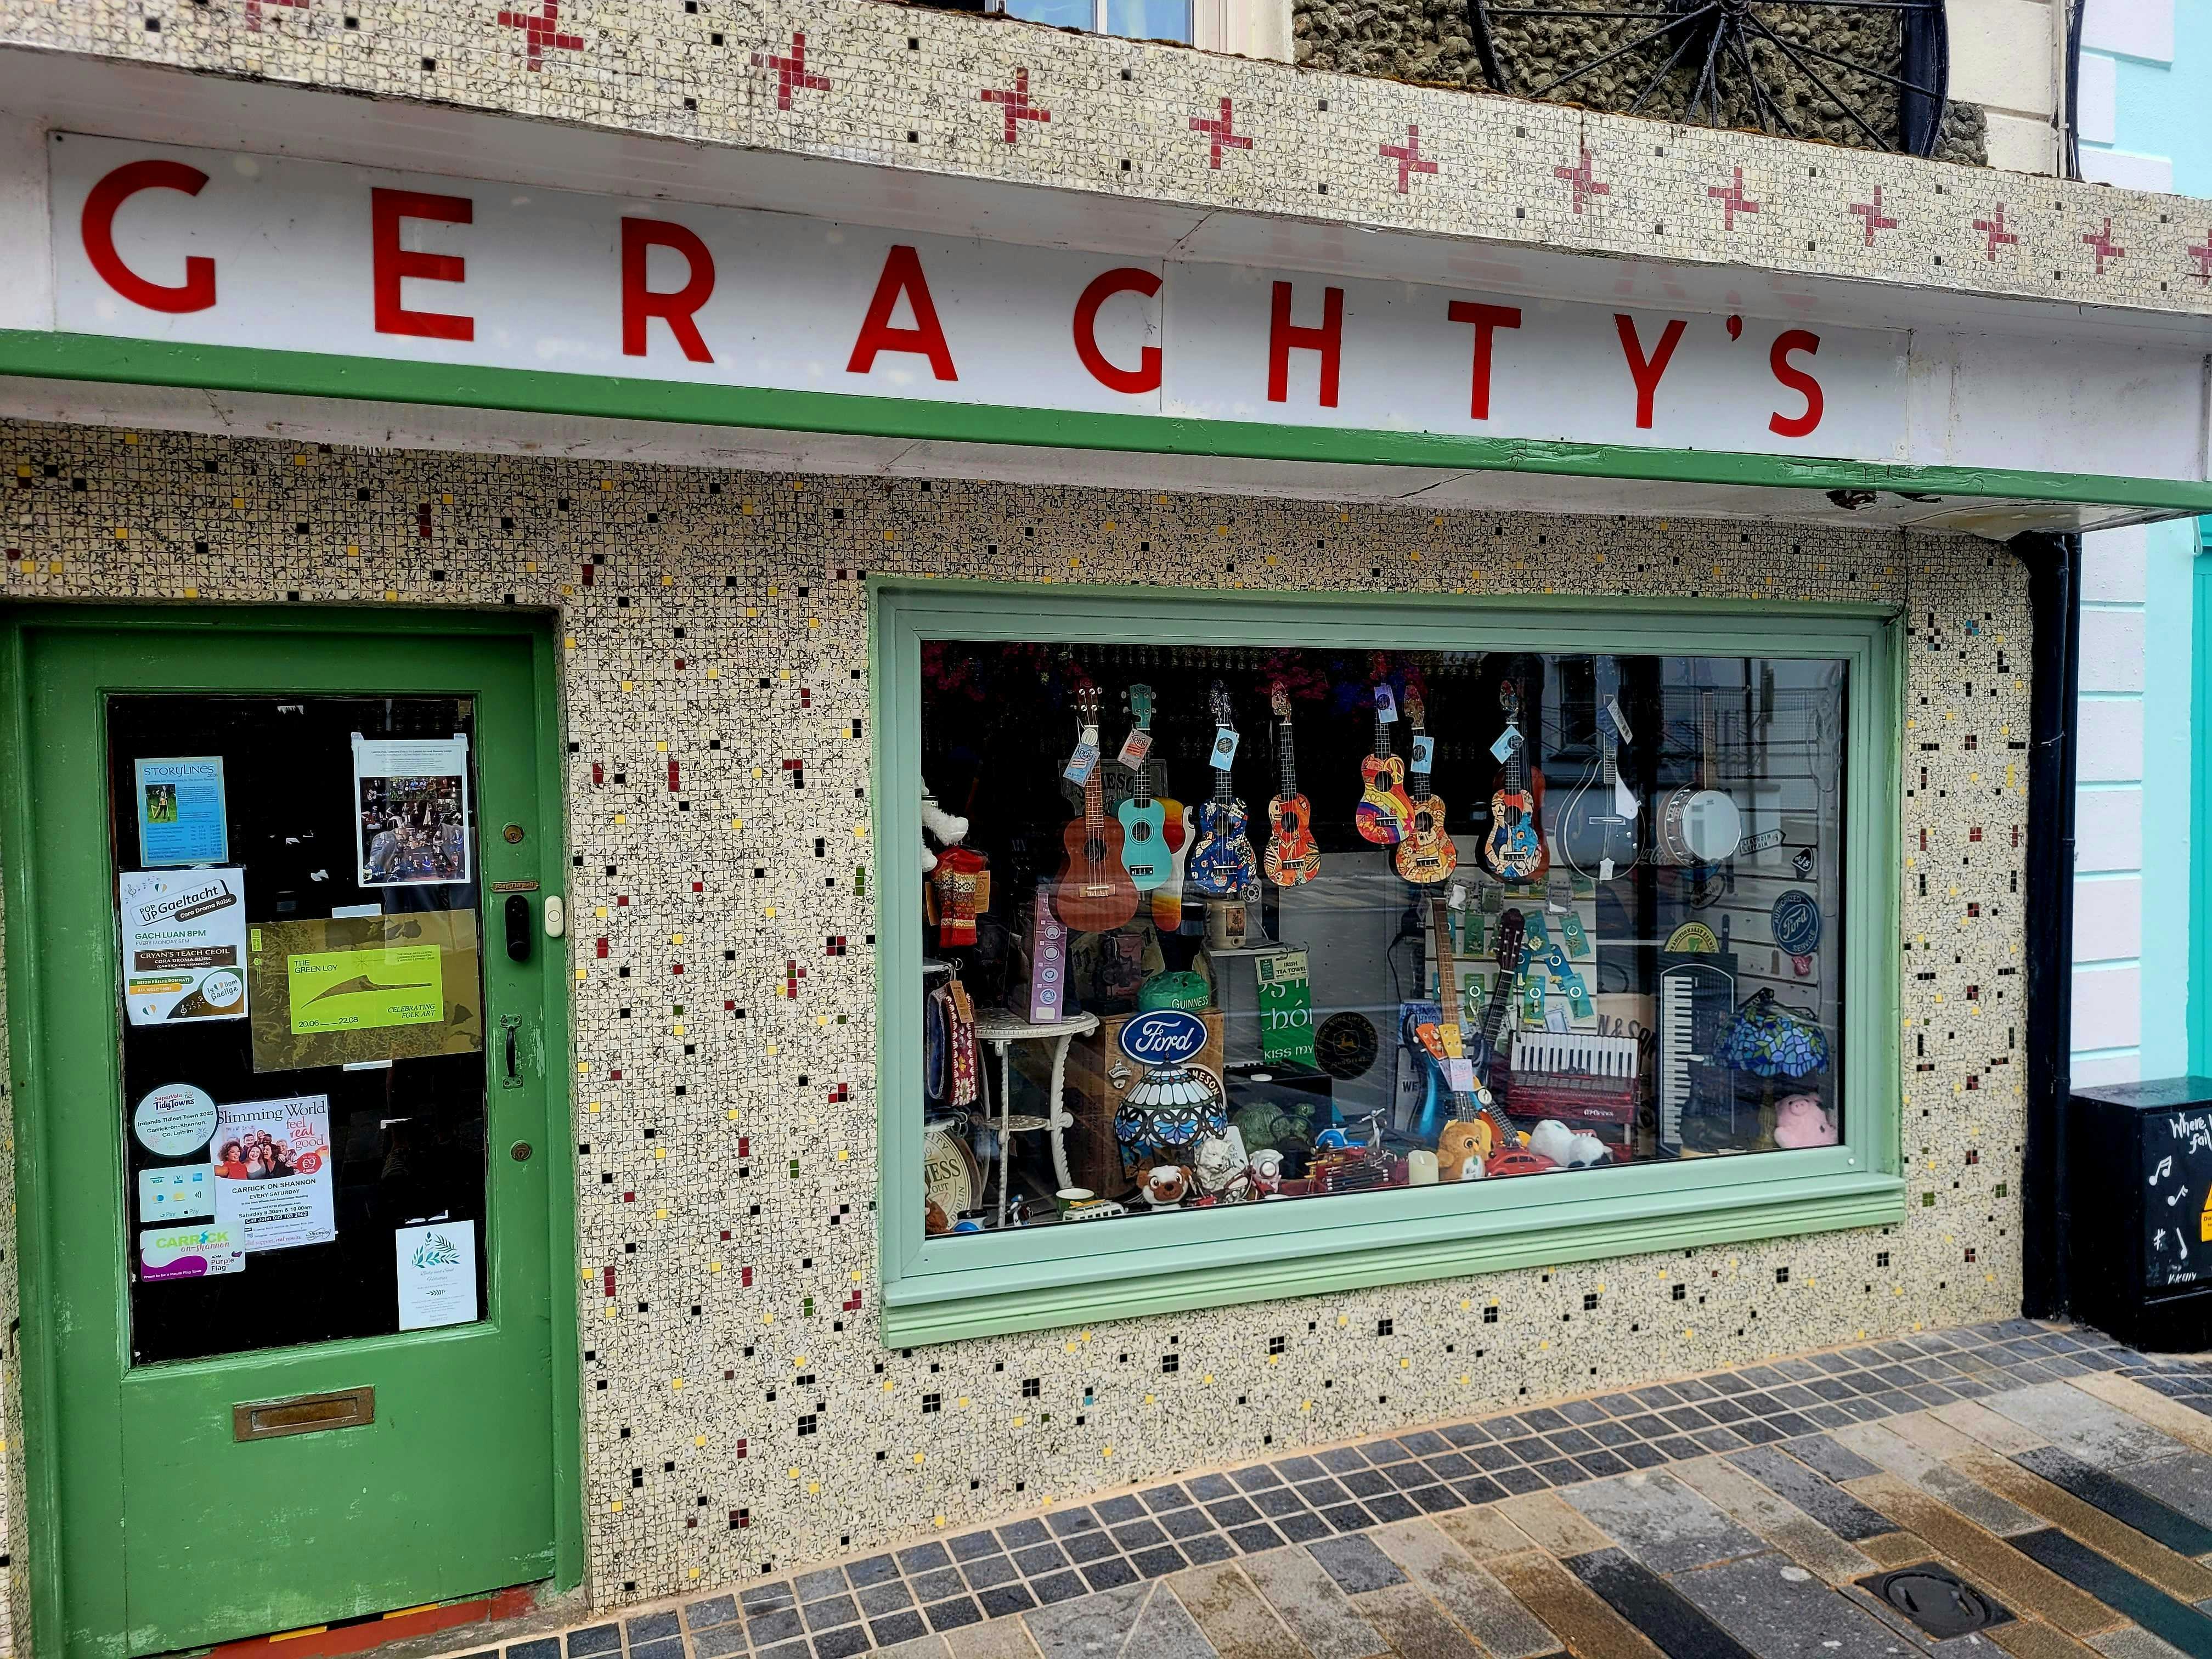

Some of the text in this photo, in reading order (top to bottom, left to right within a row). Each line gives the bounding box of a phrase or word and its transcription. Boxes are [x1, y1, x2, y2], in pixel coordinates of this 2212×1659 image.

[81, 158, 1825, 438] GERAGHTY'S
[158, 885, 219, 913] Gaeltacht
[139, 904, 155, 915] POP
[142, 911, 158, 922] UP
[180, 910, 195, 918] Cora
[195, 902, 216, 913] Droma
[1782, 906, 1808, 940] Ford
[135, 932, 161, 940] GACH
[163, 930, 185, 939] LUAN
[294, 965, 321, 974] GREEN
[223, 979, 238, 988] liom
[211, 986, 239, 1002] Gaeilge
[387, 1003, 436, 1013] CELEBRATING
[1171, 995, 1209, 1009] GUINNESS
[298, 1016, 359, 1028] 20.06 22.08
[1135, 1020, 1195, 1053] Ford
[1264, 1044, 1314, 1060] KISS MY
[1192, 1070, 1220, 1096] MESON
[153, 1098, 195, 1111] TidyTowns
[217, 1100, 326, 1125] Slimming World
[146, 1120, 207, 1133] Carrick-on-Shannon,
[286, 1116, 307, 1130] feel
[290, 1122, 315, 1138] real
[2169, 1112, 2207, 1139] Where
[295, 1134, 324, 1151] good
[232, 1184, 266, 1194] CARRICK
[280, 1178, 317, 1188] SHANNON
[932, 1183, 949, 1194] OUT
[249, 1188, 300, 1200] EVERY SATURDAY
[950, 1186, 966, 1222] DUBLIN
[180, 1241, 229, 1252] on-shannon
